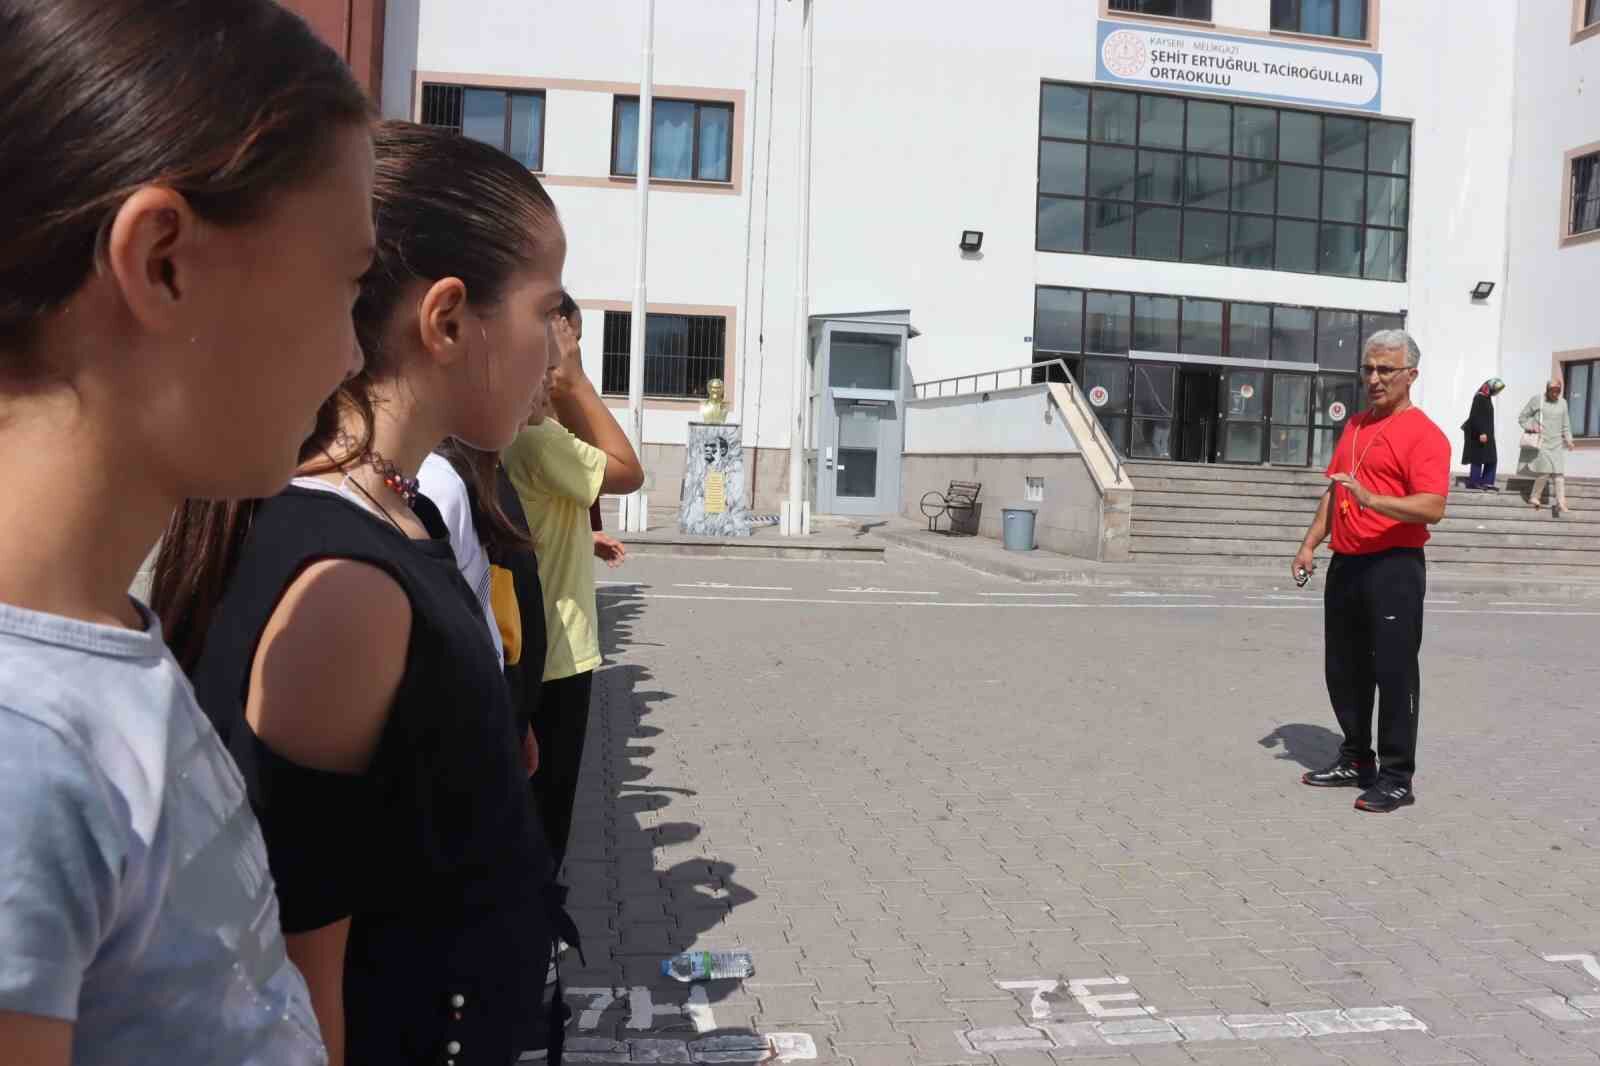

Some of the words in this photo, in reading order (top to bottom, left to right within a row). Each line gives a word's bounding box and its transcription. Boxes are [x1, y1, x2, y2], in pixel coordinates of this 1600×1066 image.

[1150, 67, 1232, 86] ORTAOKULU
[1151, 50, 1188, 65] ŞEHİT
[1192, 55, 1260, 74] ERTUĞRUL
[1263, 63, 1363, 87] TACİROĞULLARI
